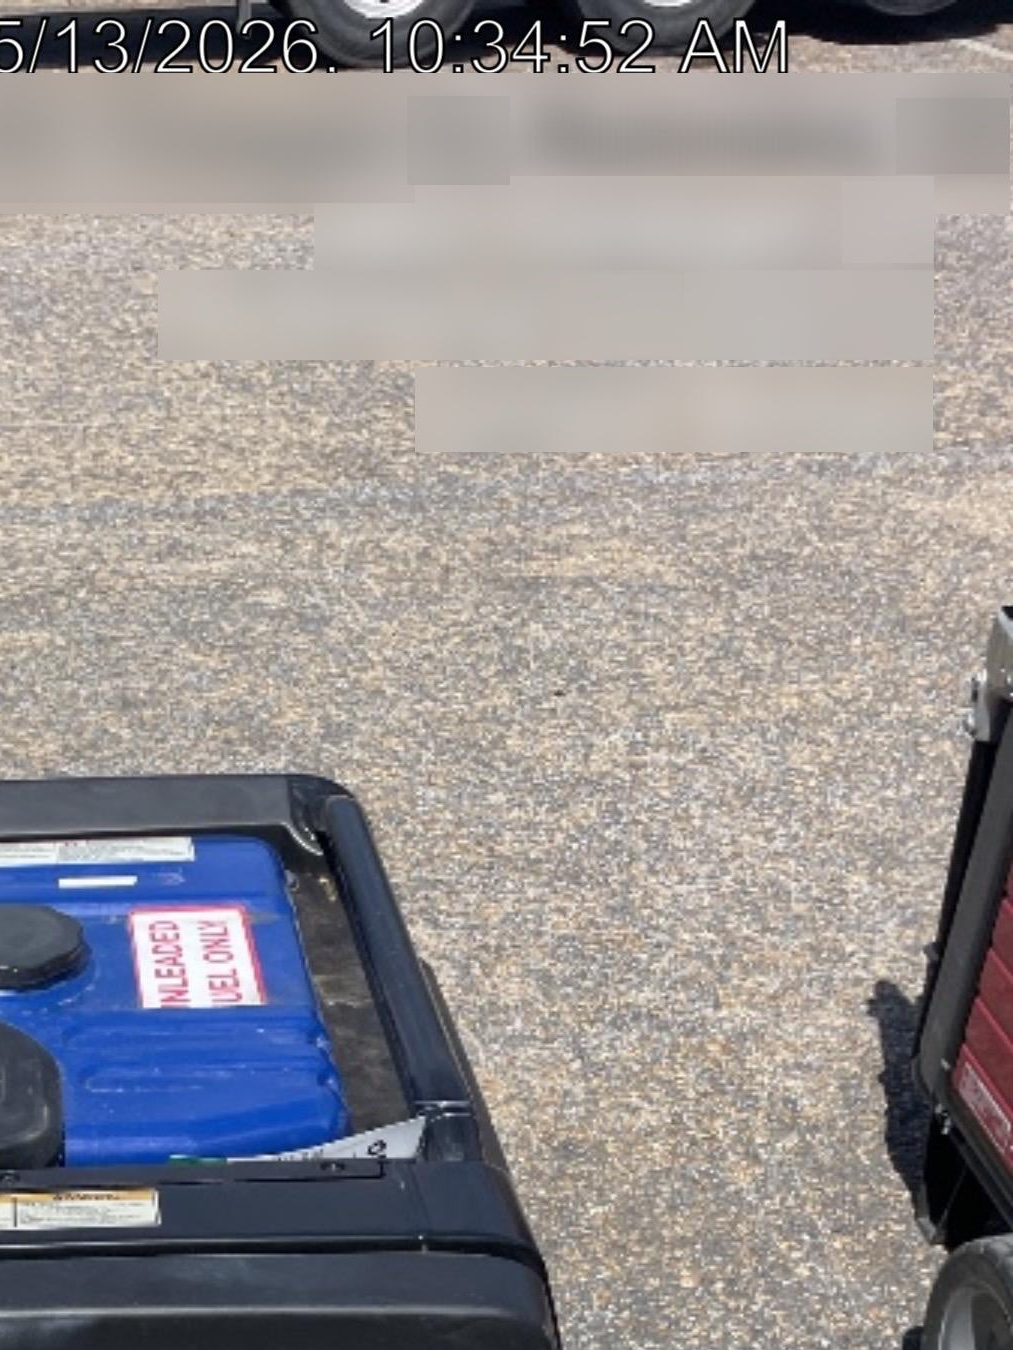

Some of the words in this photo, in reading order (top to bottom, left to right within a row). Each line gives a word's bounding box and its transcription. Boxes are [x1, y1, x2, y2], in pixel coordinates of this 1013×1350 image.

[196, 920, 234, 963] ONLY
[149, 920, 191, 1008] NLEADED
[205, 969, 243, 1007] UEL
